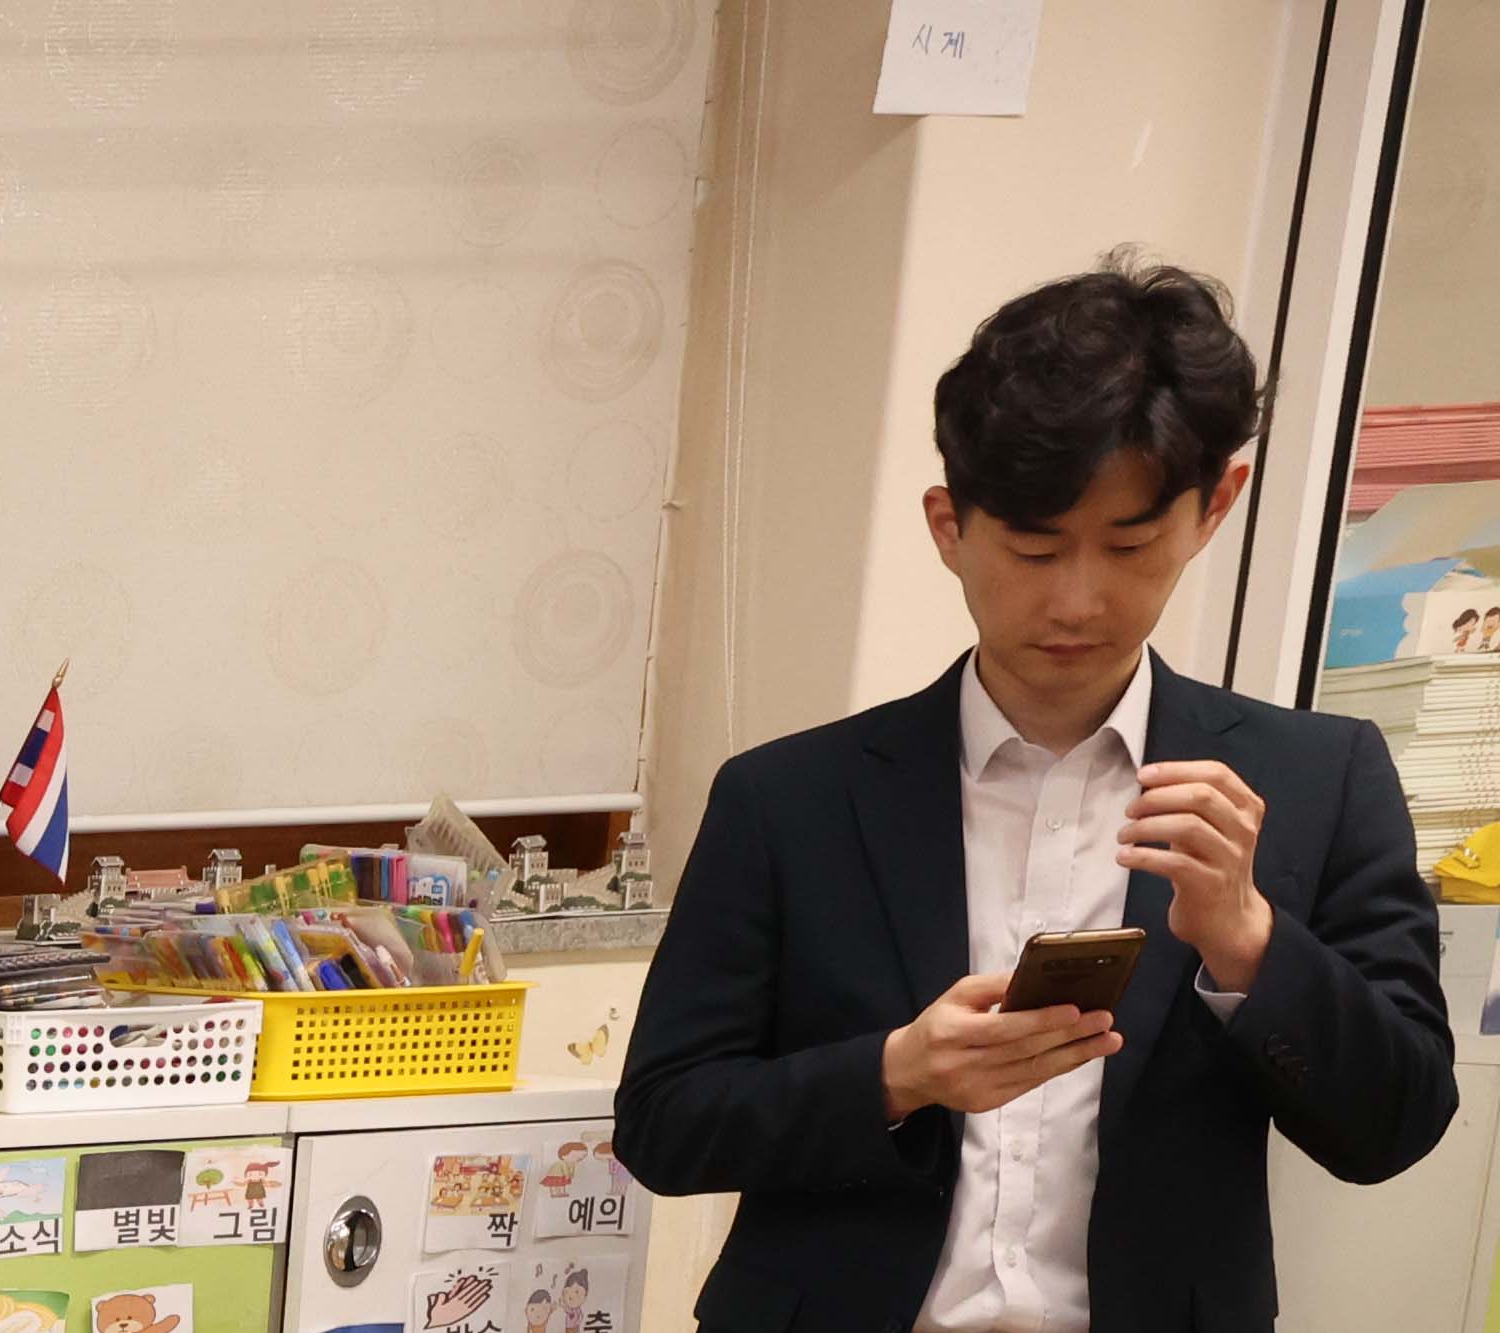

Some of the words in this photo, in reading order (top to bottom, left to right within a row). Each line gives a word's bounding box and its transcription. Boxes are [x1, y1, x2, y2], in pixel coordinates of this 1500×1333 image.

[112, 1206, 177, 1244] 별빛
[213, 1207, 277, 1243] 그림
[486, 1211, 519, 1248] 짝
[567, 1194, 626, 1233] 예의
